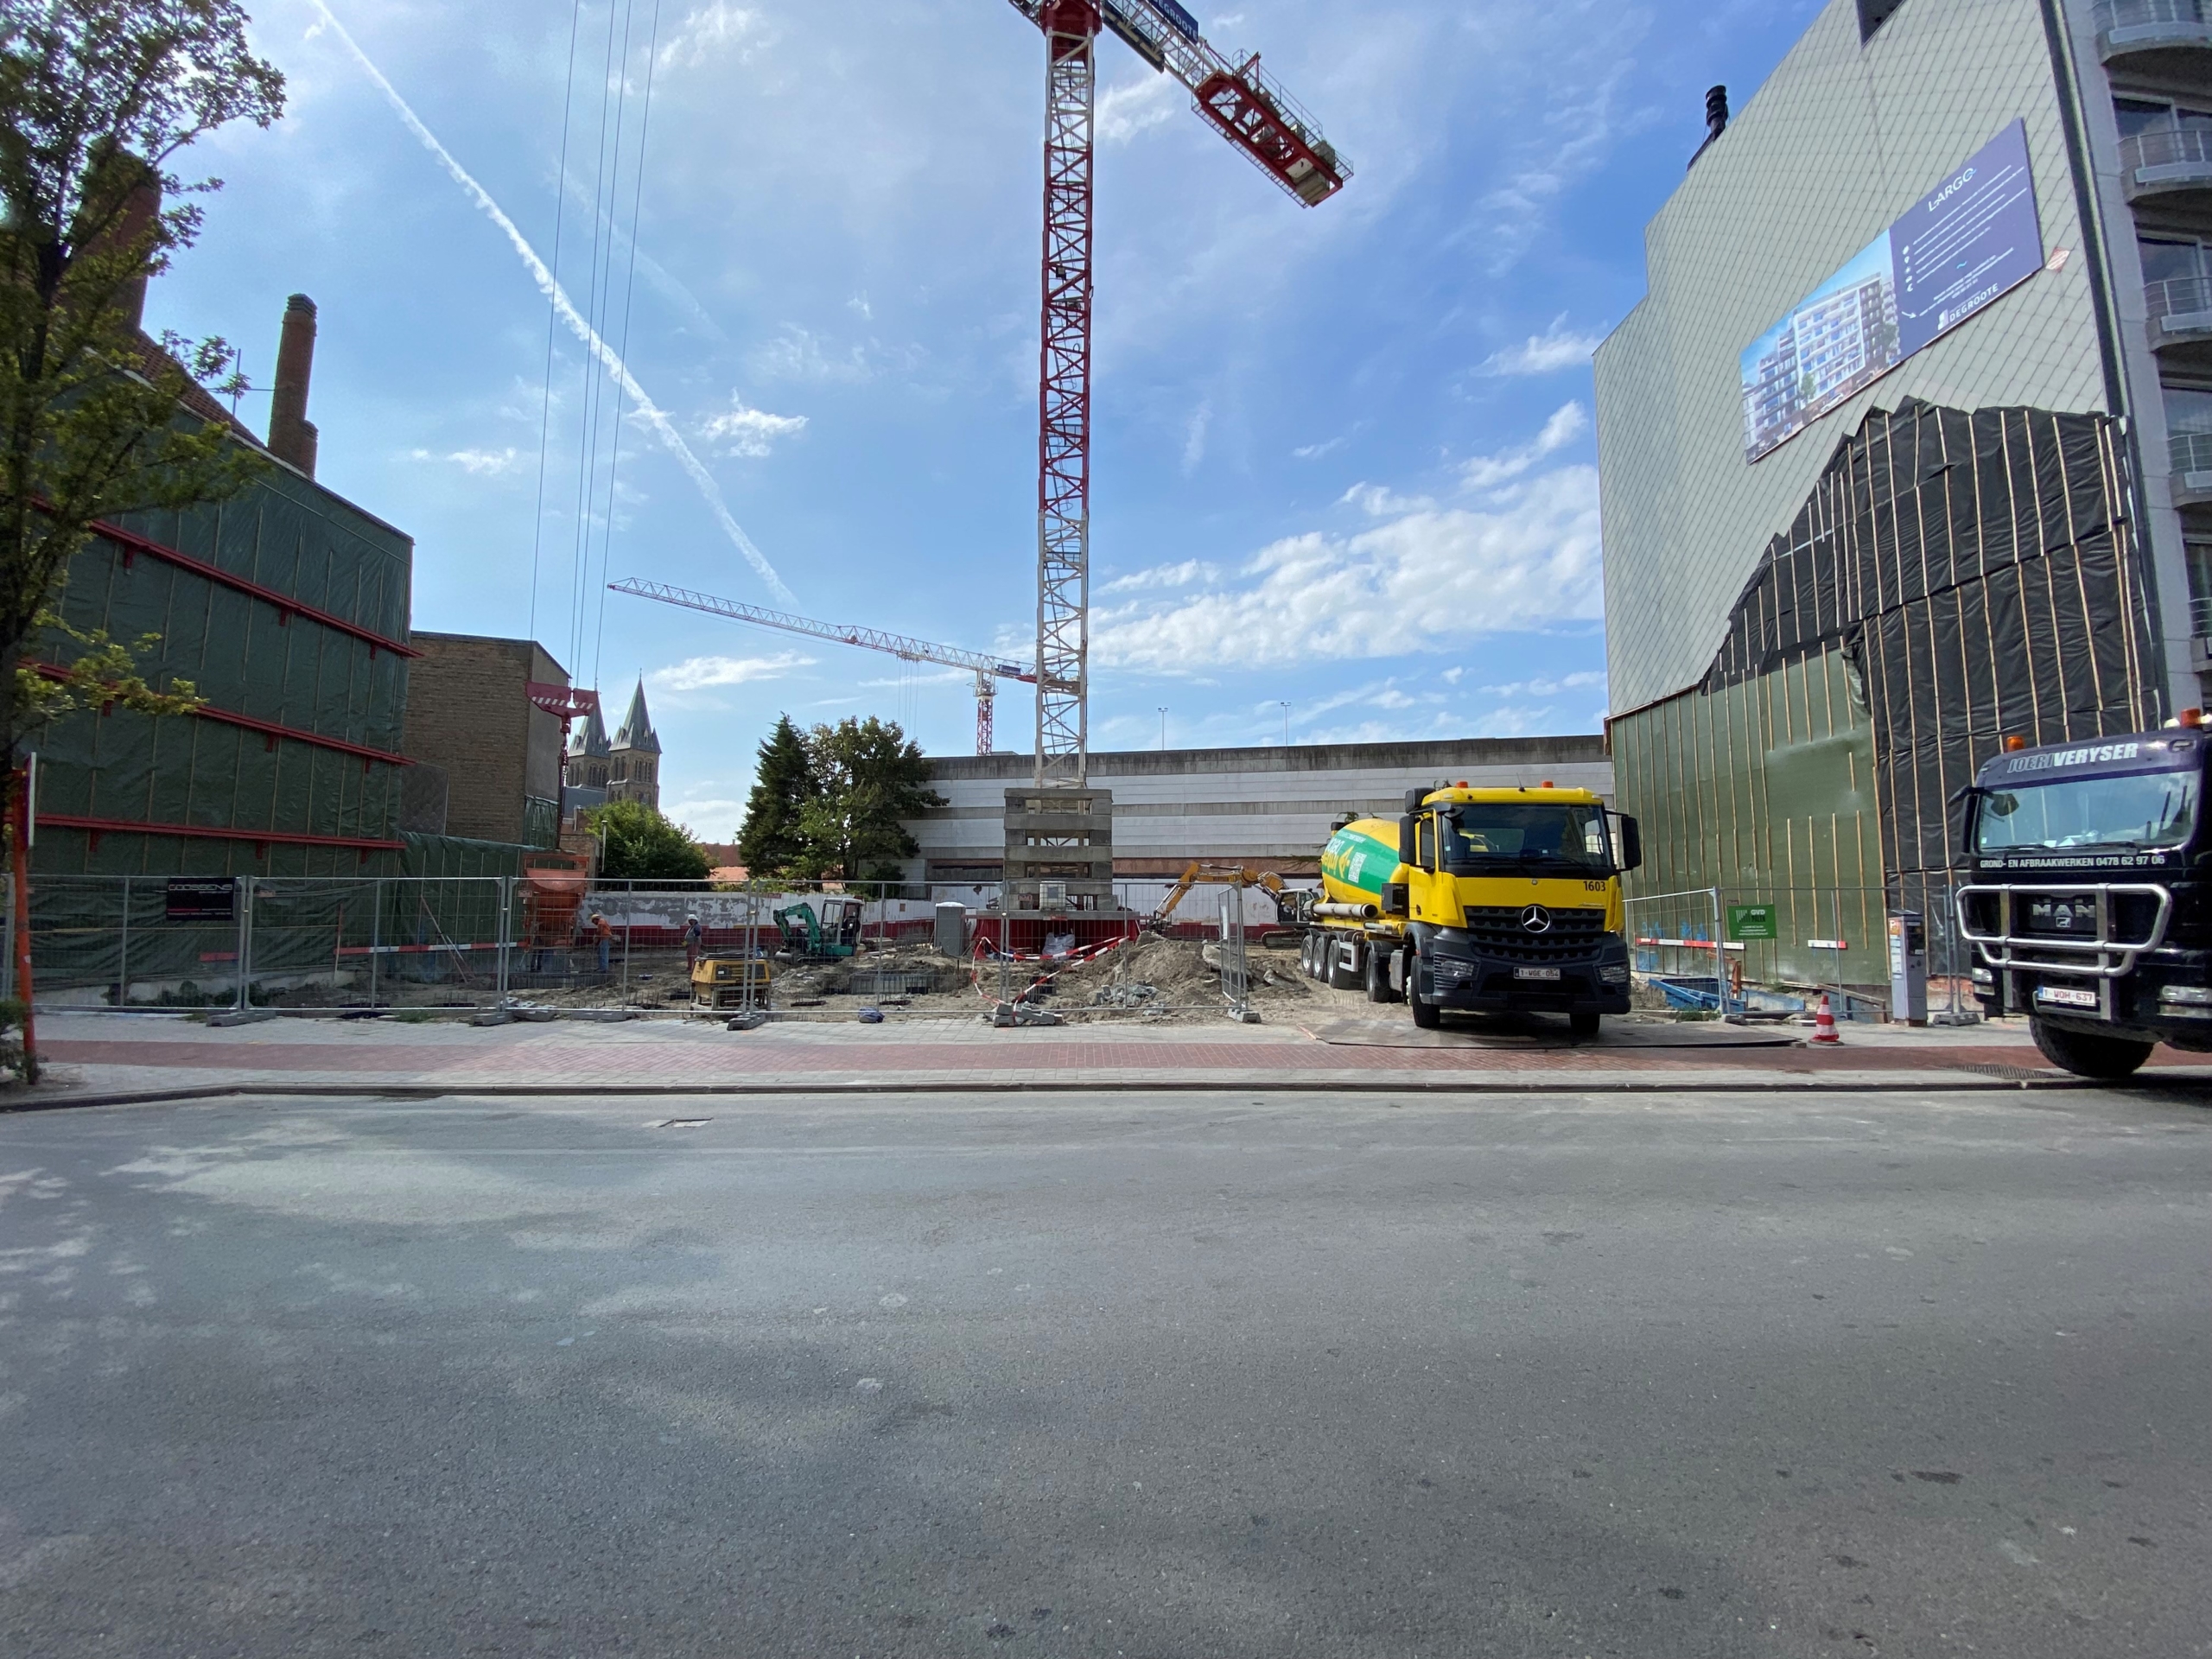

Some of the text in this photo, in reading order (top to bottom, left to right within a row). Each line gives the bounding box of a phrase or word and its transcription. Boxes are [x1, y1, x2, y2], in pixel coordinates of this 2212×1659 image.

[1153, 0, 1198, 41] EGROOTE
[1928, 168, 1977, 212] LARGO
[1949, 283, 1999, 322] DEGROOTE
[2008, 859, 2018, 868] EN
[2019, 857, 2094, 868] AFBRAAKWERKEN
[2095, 856, 2120, 867] 0478
[2121, 856, 2134, 866] 62
[2136, 855, 2149, 865] 97
[1583, 880, 1606, 892] 1603
[2032, 904, 2095, 918] MAN
